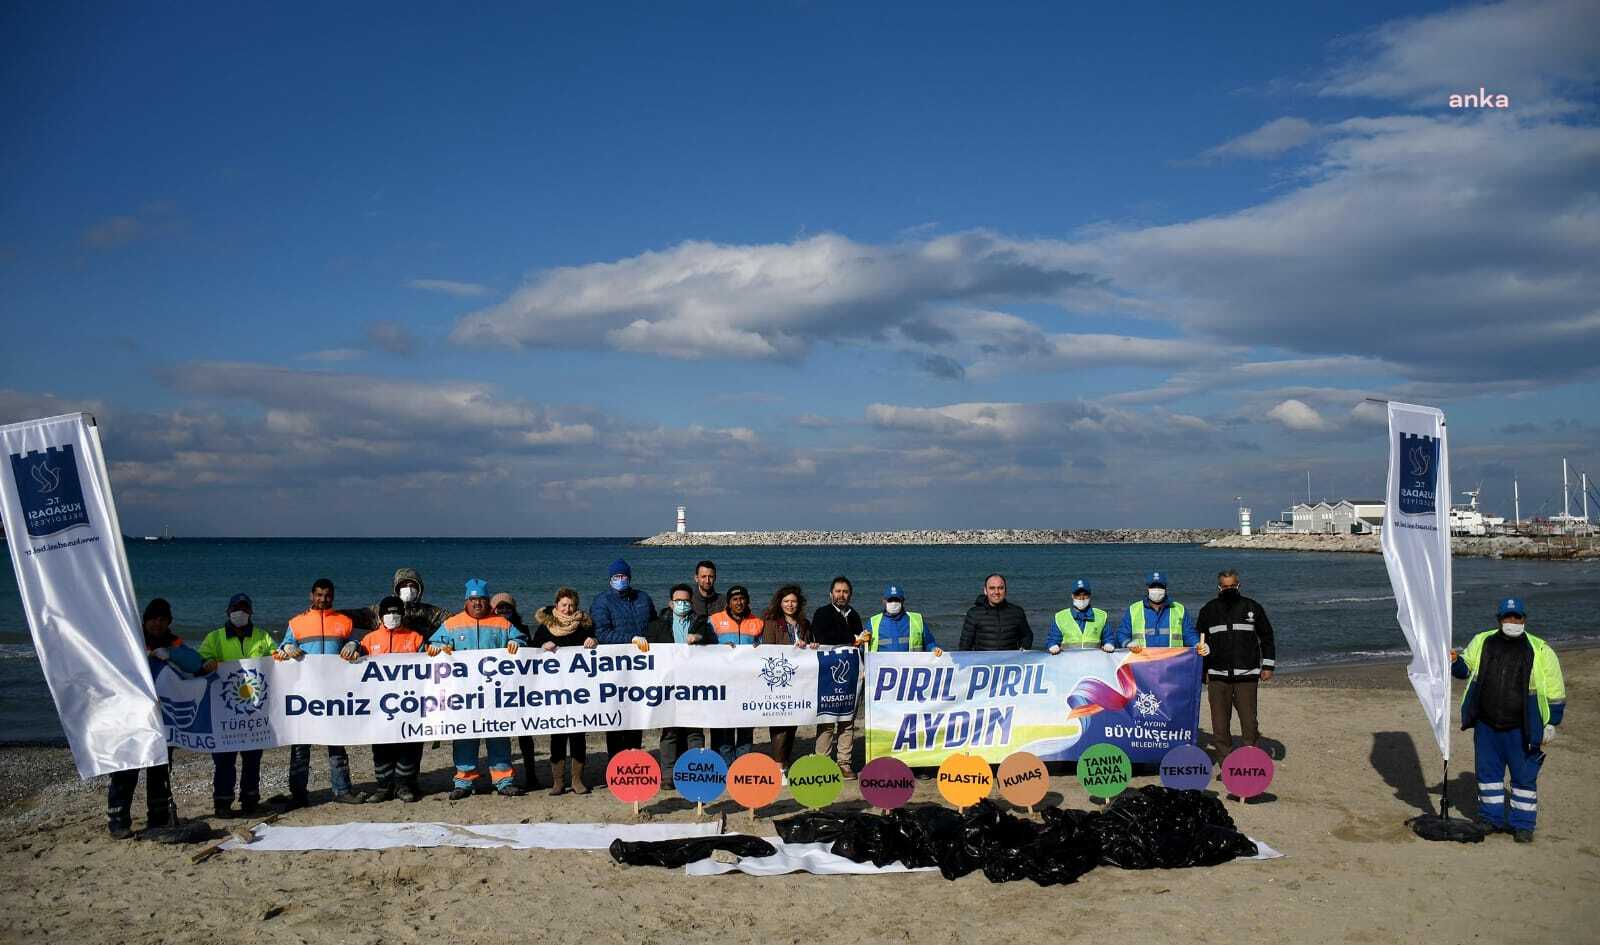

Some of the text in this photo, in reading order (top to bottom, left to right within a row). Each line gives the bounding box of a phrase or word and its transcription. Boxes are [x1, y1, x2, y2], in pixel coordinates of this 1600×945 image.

[361, 650, 655, 684] Avrupa Çevre Ajansı
[873, 664, 1050, 703] PIRIL PIRIL
[285, 680, 726, 721] Deniz Çöpleri İzleme Programı
[742, 699, 812, 712] BÜYÜKŞEHİR
[220, 716, 270, 731] TÜRÇEV
[400, 710, 622, 739] (Marine Litter Watch-MLV)
[893, 705, 1015, 751] AYDIN
[1105, 725, 1192, 742] BÜYÜKŞEHİR
[1131, 741, 1169, 749] BELEDİYESİ
[1084, 755, 1122, 766] TANIM
[616, 764, 651, 775] KAĞIT
[687, 762, 714, 772] CAM
[1088, 765, 1122, 776] LANA
[1162, 764, 1209, 776] TEKSTİL
[1229, 767, 1266, 777] TAHTA
[610, 776, 658, 786] KARTON
[674, 771, 727, 784] SERAMİK
[734, 775, 774, 785] METAL
[789, 773, 840, 787] KAUÇUK
[860, 778, 915, 789] ORGANİK
[939, 773, 990, 785] PLASTİK
[1003, 768, 1042, 788] KUMAŞ
[1083, 774, 1127, 786] MAYAN
